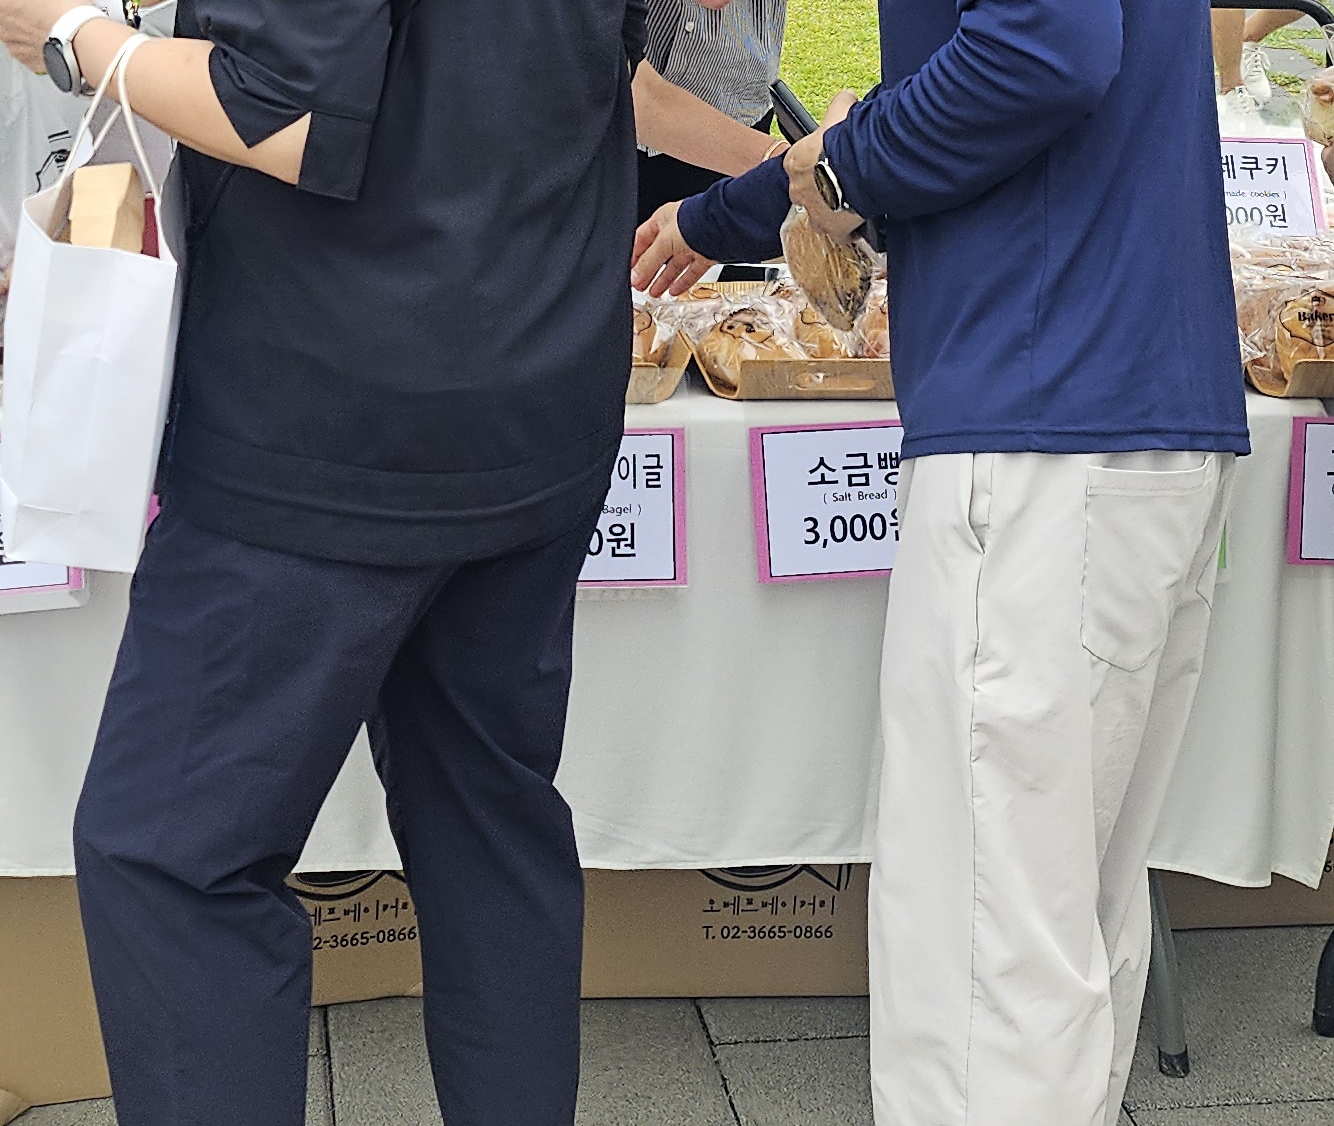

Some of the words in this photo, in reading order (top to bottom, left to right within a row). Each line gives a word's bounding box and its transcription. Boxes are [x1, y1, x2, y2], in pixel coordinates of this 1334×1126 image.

[832, 490, 852, 503] Salt
[857, 489, 888, 502] Bread
[702, 925, 716, 939] T.
[720, 925, 834, 940] 02-3665-0866
